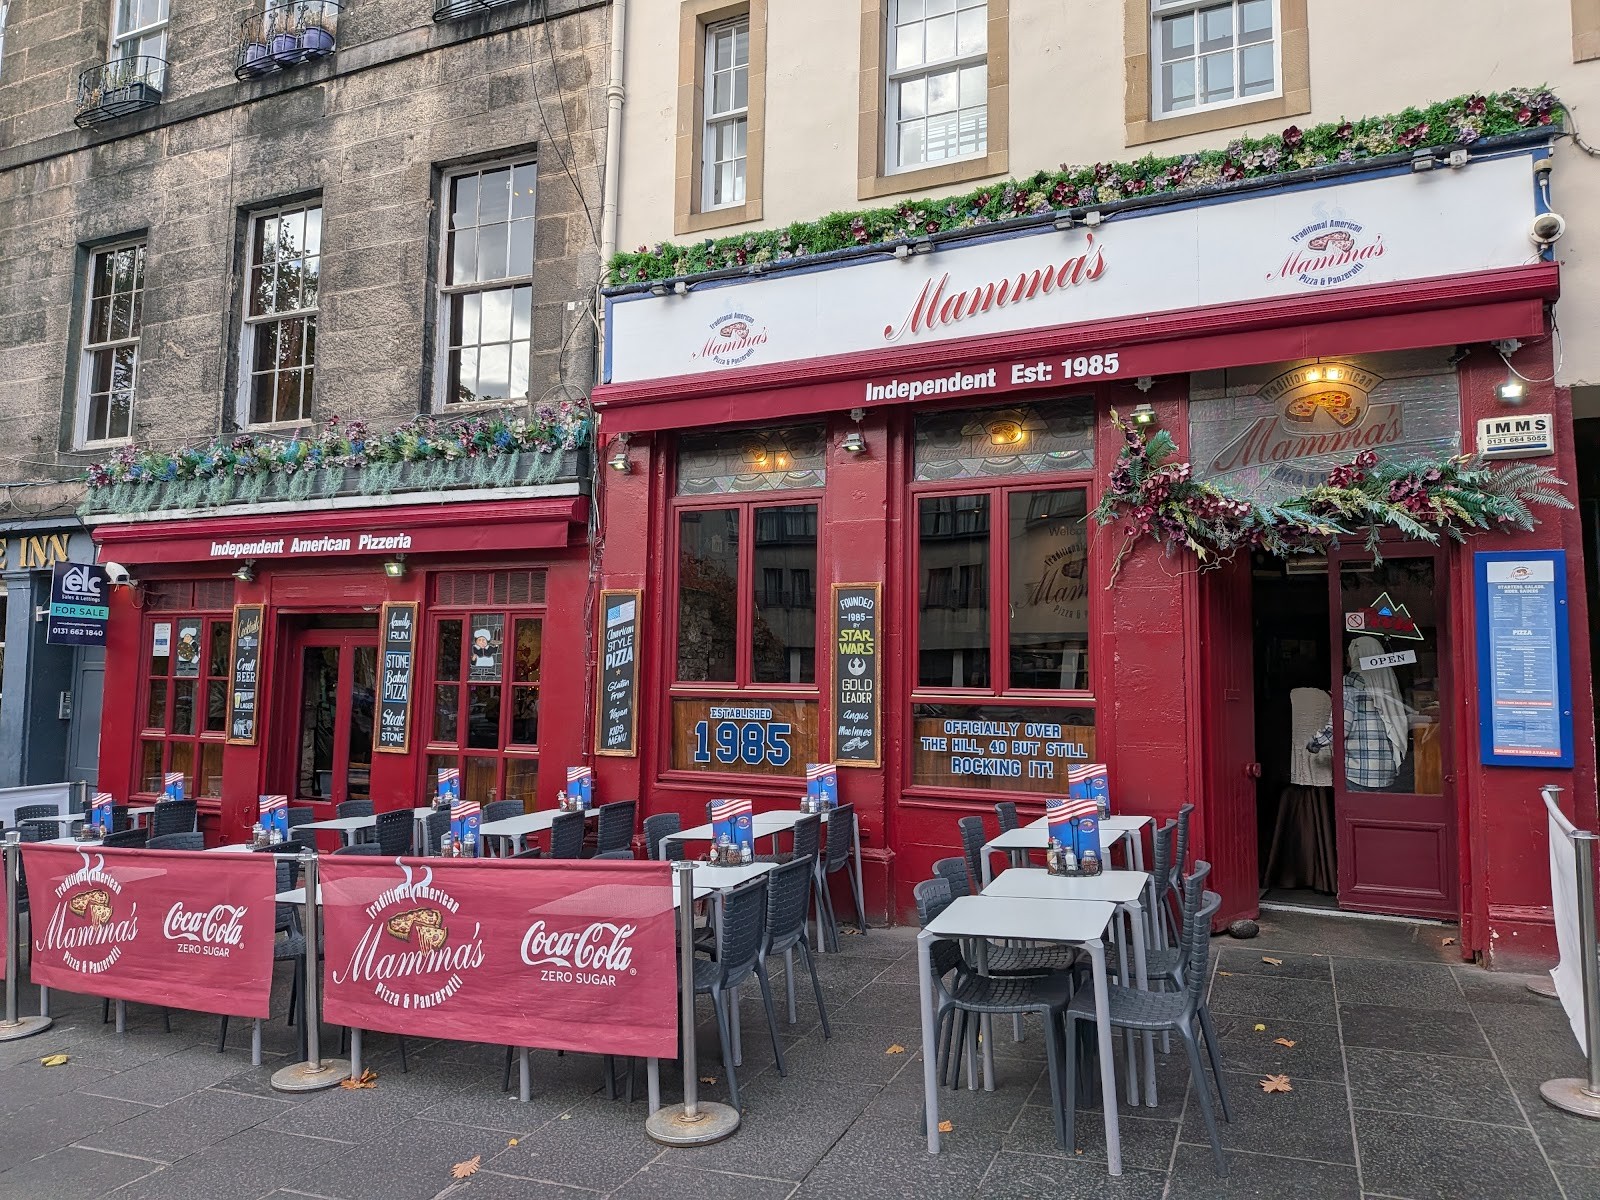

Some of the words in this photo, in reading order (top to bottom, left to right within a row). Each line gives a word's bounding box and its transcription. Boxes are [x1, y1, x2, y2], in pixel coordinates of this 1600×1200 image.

[1290, 220, 1328, 243] Traditional
[1329, 219, 1363, 233] American
[1266, 235, 1386, 281] Mamma's
[1299, 273, 1318, 286] Pizza
[1320, 277, 1325, 286] &
[1327, 262, 1365, 285] Panzerotti
[884, 233, 1108, 342] Mamma's
[709, 313, 733, 330] Traditional
[734, 312, 755, 324] American
[691, 326, 768, 360] Mamma's
[866, 368, 996, 401] Independent
[1011, 361, 1052, 384] Est:
[1061, 353, 1119, 378] 1985
[1260, 367, 1317, 402] Tradition
[1321, 366, 1374, 389] Aerican
[1486, 419, 1546, 435] IMMS
[1214, 403, 1402, 471] Mamma's
[1048, 526, 1087, 537] Welco
[19, 533, 70, 568] INN
[210, 538, 285, 558] Independent
[290, 535, 351, 553] American
[358, 532, 412, 550] Pizzeria
[66, 566, 101, 594] elc
[80, 595, 101, 603] Lettings
[840, 596, 874, 610] FOUNDED
[55, 606, 76, 615] FOR
[79, 608, 105, 617] SALE
[848, 613, 866, 622] 1985
[52, 627, 68, 635] 0131
[69, 628, 84, 636] 662
[85, 629, 103, 637] 1840
[390, 631, 409, 640] RUN
[838, 629, 874, 642] STAR
[607, 635, 633, 653] STYLE
[838, 643, 874, 655] WARS
[386, 654, 410, 669] STONE
[605, 645, 634, 671] PIZZA
[1370, 653, 1406, 667] OPEN
[236, 671, 256, 683] BEER
[842, 678, 873, 691] GOLD
[385, 684, 407, 700] PIZZA
[841, 692, 872, 704] LEADER
[709, 707, 773, 720] ESTABLISHED
[842, 710, 869, 724] Angus
[381, 732, 405, 743] STONE
[944, 719, 1021, 737] OFFICIALLY
[1024, 723, 1062, 739] OVER
[607, 732, 628, 747] MENU
[694, 720, 792, 767] 1985
[921, 736, 947, 752] THE
[951, 737, 985, 756] HILL,
[988, 740, 1007, 755] 40
[1011, 740, 1041, 756] BUT
[1045, 742, 1088, 759] STILL
[951, 756, 1022, 777] ROCKING
[1028, 760, 1054, 779] IT!
[55, 872, 89, 899] Traditional
[90, 870, 122, 895] American
[365, 884, 413, 920] Traditional
[415, 884, 460, 914] American
[35, 901, 139, 952] Mamma's
[163, 901, 249, 945] Coca-Cola
[177, 943, 201, 954] ZERO
[202, 945, 230, 958] SUGAR
[332, 921, 486, 985] Mamma's
[520, 920, 638, 971] Coca-Cola
[62, 950, 80, 971] Pizza
[82, 960, 87, 973] &
[89, 945, 122, 974] Panzerotti
[540, 969, 573, 983] ZERO
[575, 972, 617, 987] SUGAR
[374, 981, 400, 1007] Pizza
[403, 993, 409, 1009] &
[413, 972, 463, 1009] Panzerotti
